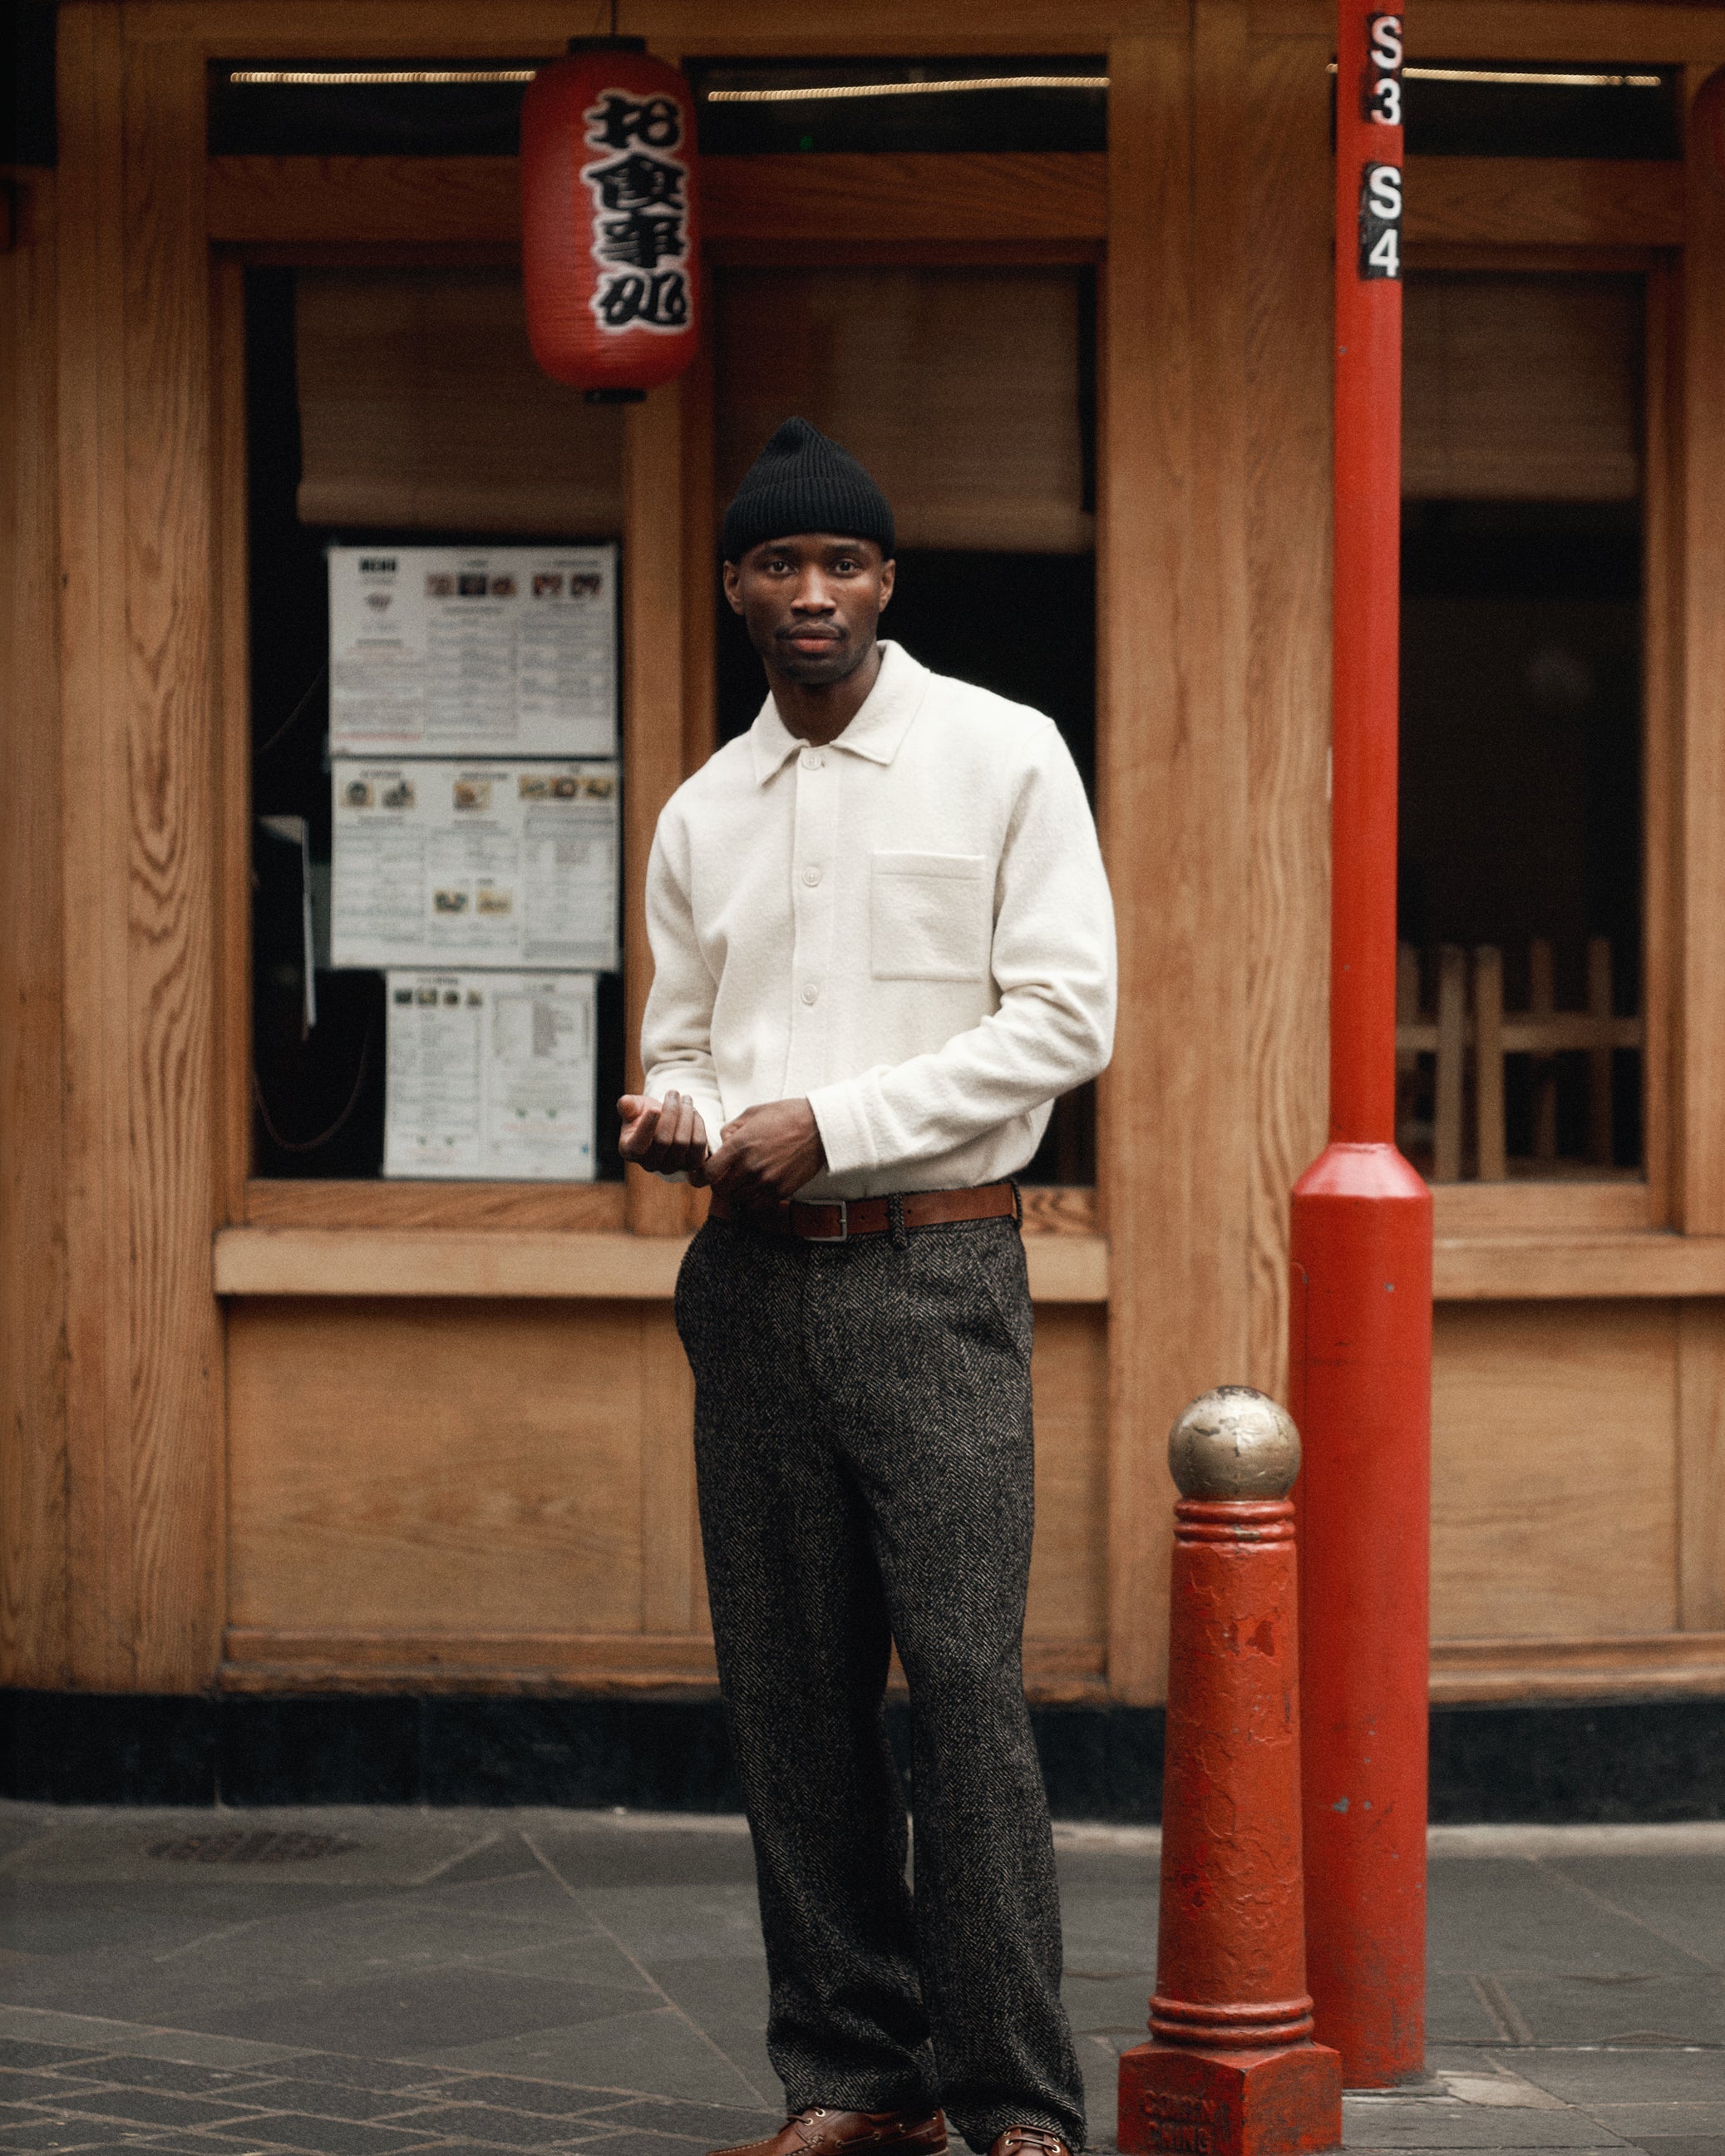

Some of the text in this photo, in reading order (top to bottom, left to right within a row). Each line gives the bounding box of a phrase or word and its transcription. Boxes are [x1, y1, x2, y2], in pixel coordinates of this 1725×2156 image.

[1371, 16, 1402, 126] S3
[584, 91, 691, 330] お食事処
[1369, 165, 1402, 278] S4
